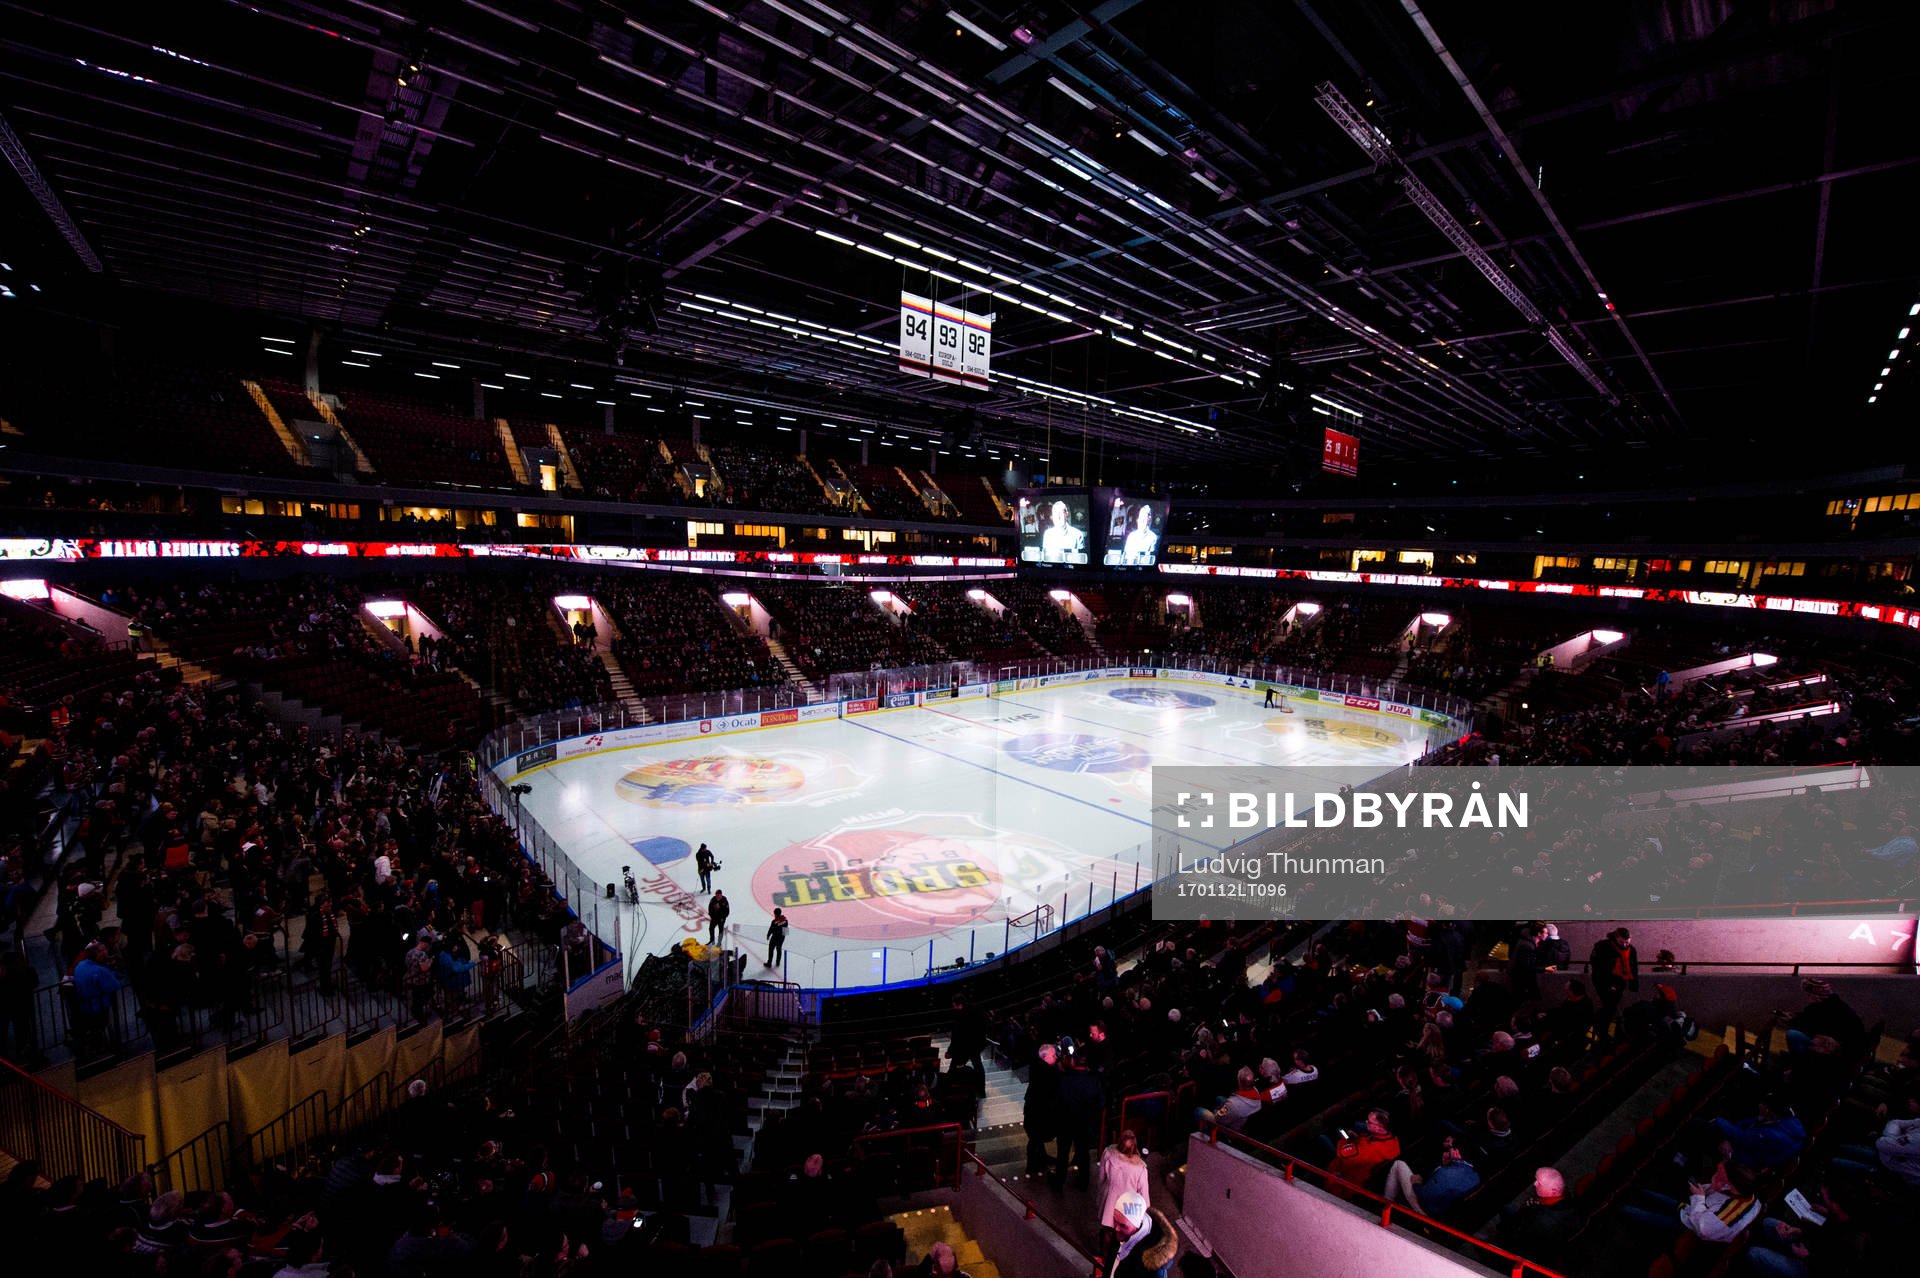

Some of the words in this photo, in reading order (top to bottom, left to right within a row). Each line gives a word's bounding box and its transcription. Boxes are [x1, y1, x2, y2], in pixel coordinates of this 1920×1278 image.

[906, 314, 927, 341] 94
[939, 324, 957, 348] 93
[968, 333, 985, 356] 92
[100, 541, 157, 557] MALMÖ
[161, 542, 240, 557] REDHAWKS
[1346, 697, 1379, 708] CCM
[1386, 704, 1413, 716] JULA
[731, 717, 757, 728] Ocab
[776, 862, 990, 908] SPORT
[640, 873, 712, 933] Scandic
